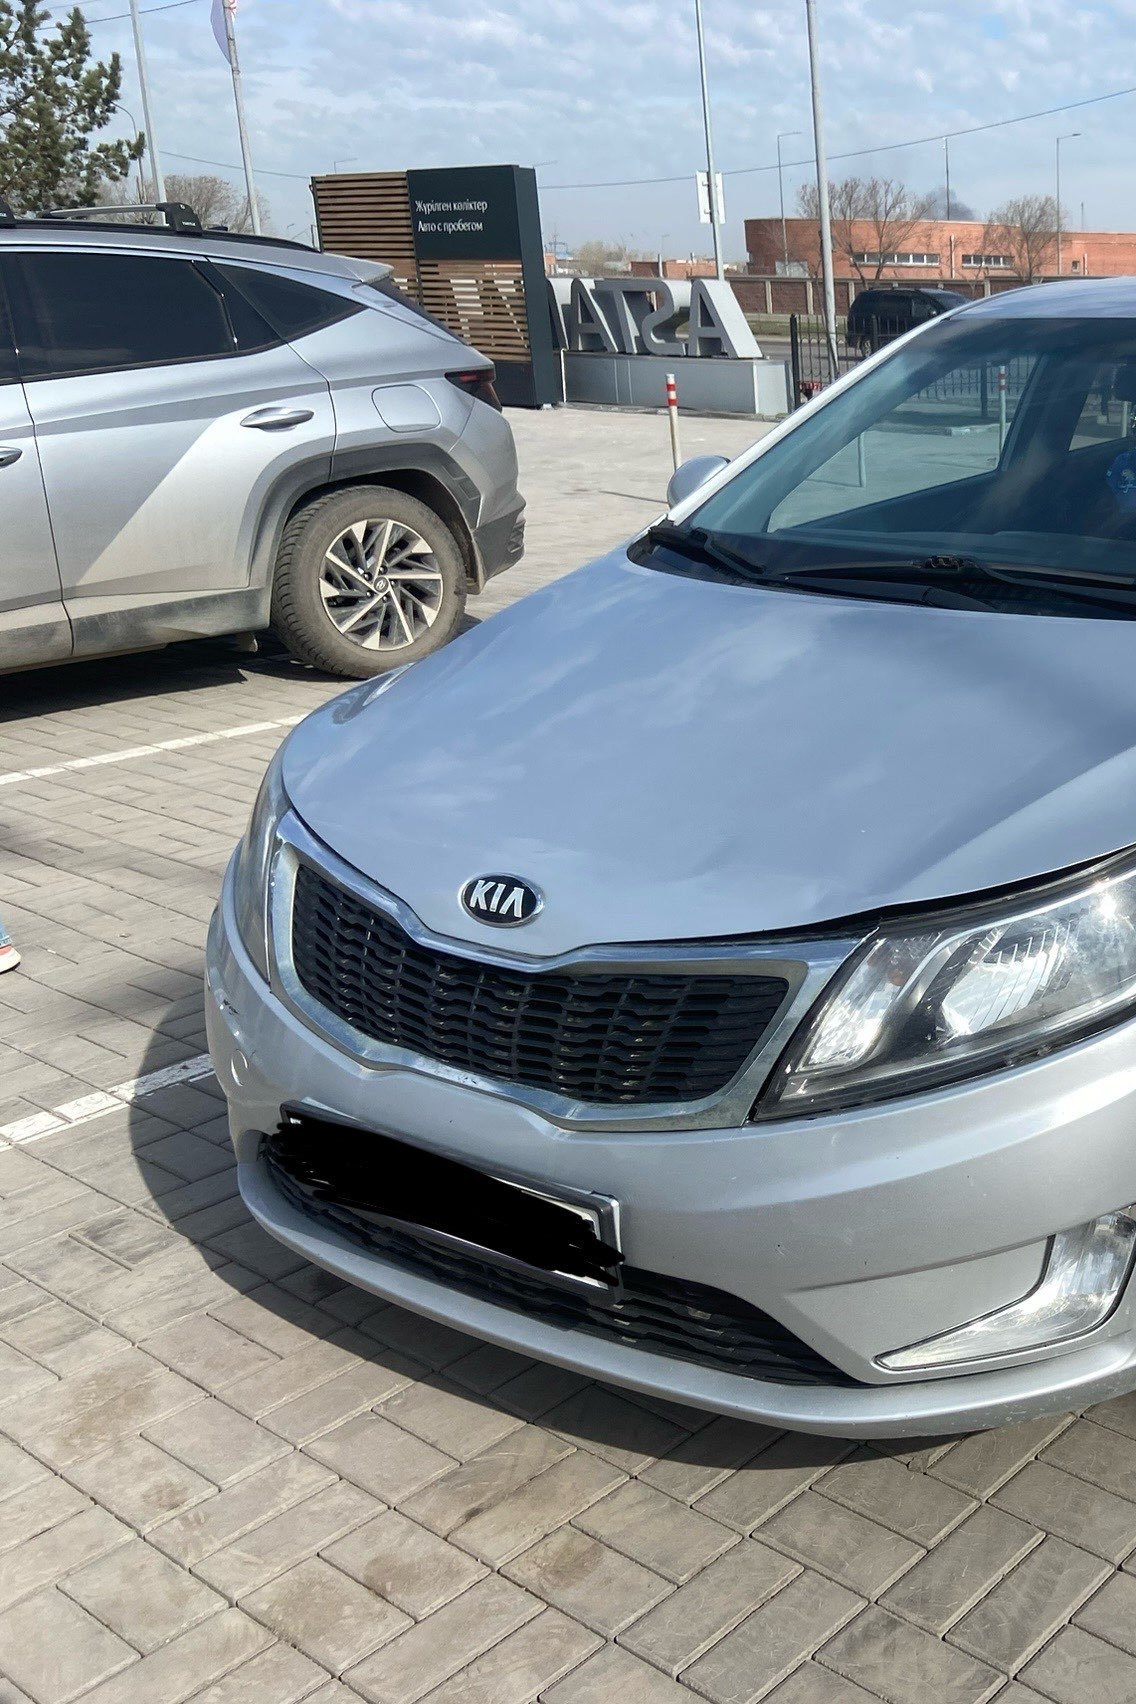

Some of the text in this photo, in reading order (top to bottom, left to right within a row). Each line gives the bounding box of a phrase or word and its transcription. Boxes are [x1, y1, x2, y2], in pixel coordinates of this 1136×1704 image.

[418, 220, 437, 232] Авто
[443, 218, 483, 235] пробегом
[469, 879, 525, 918] KIA
